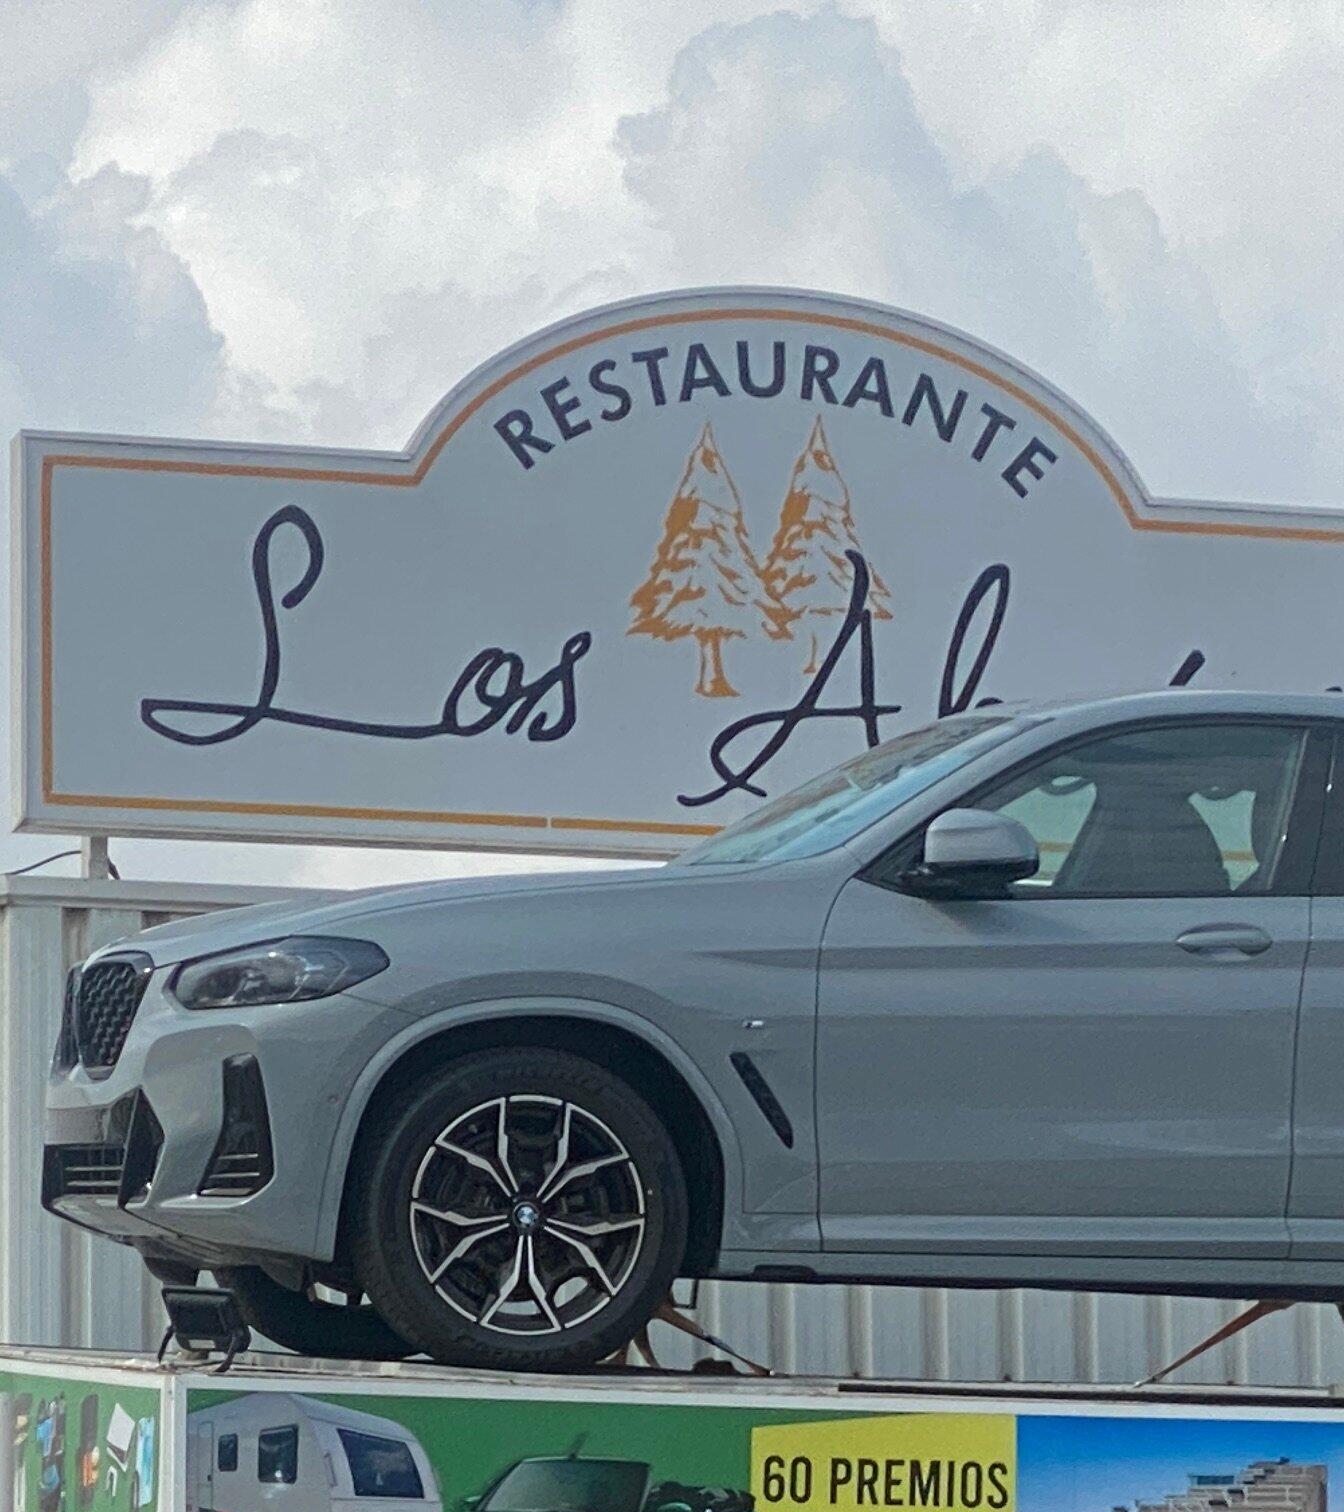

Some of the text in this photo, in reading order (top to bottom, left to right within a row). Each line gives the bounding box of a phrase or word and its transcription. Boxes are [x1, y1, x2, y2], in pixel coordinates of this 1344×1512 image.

[495, 341, 1057, 500] RESTAURANTE
[141, 504, 592, 746] Los
[763, 1456, 1009, 1510] 60 PREMIOS
